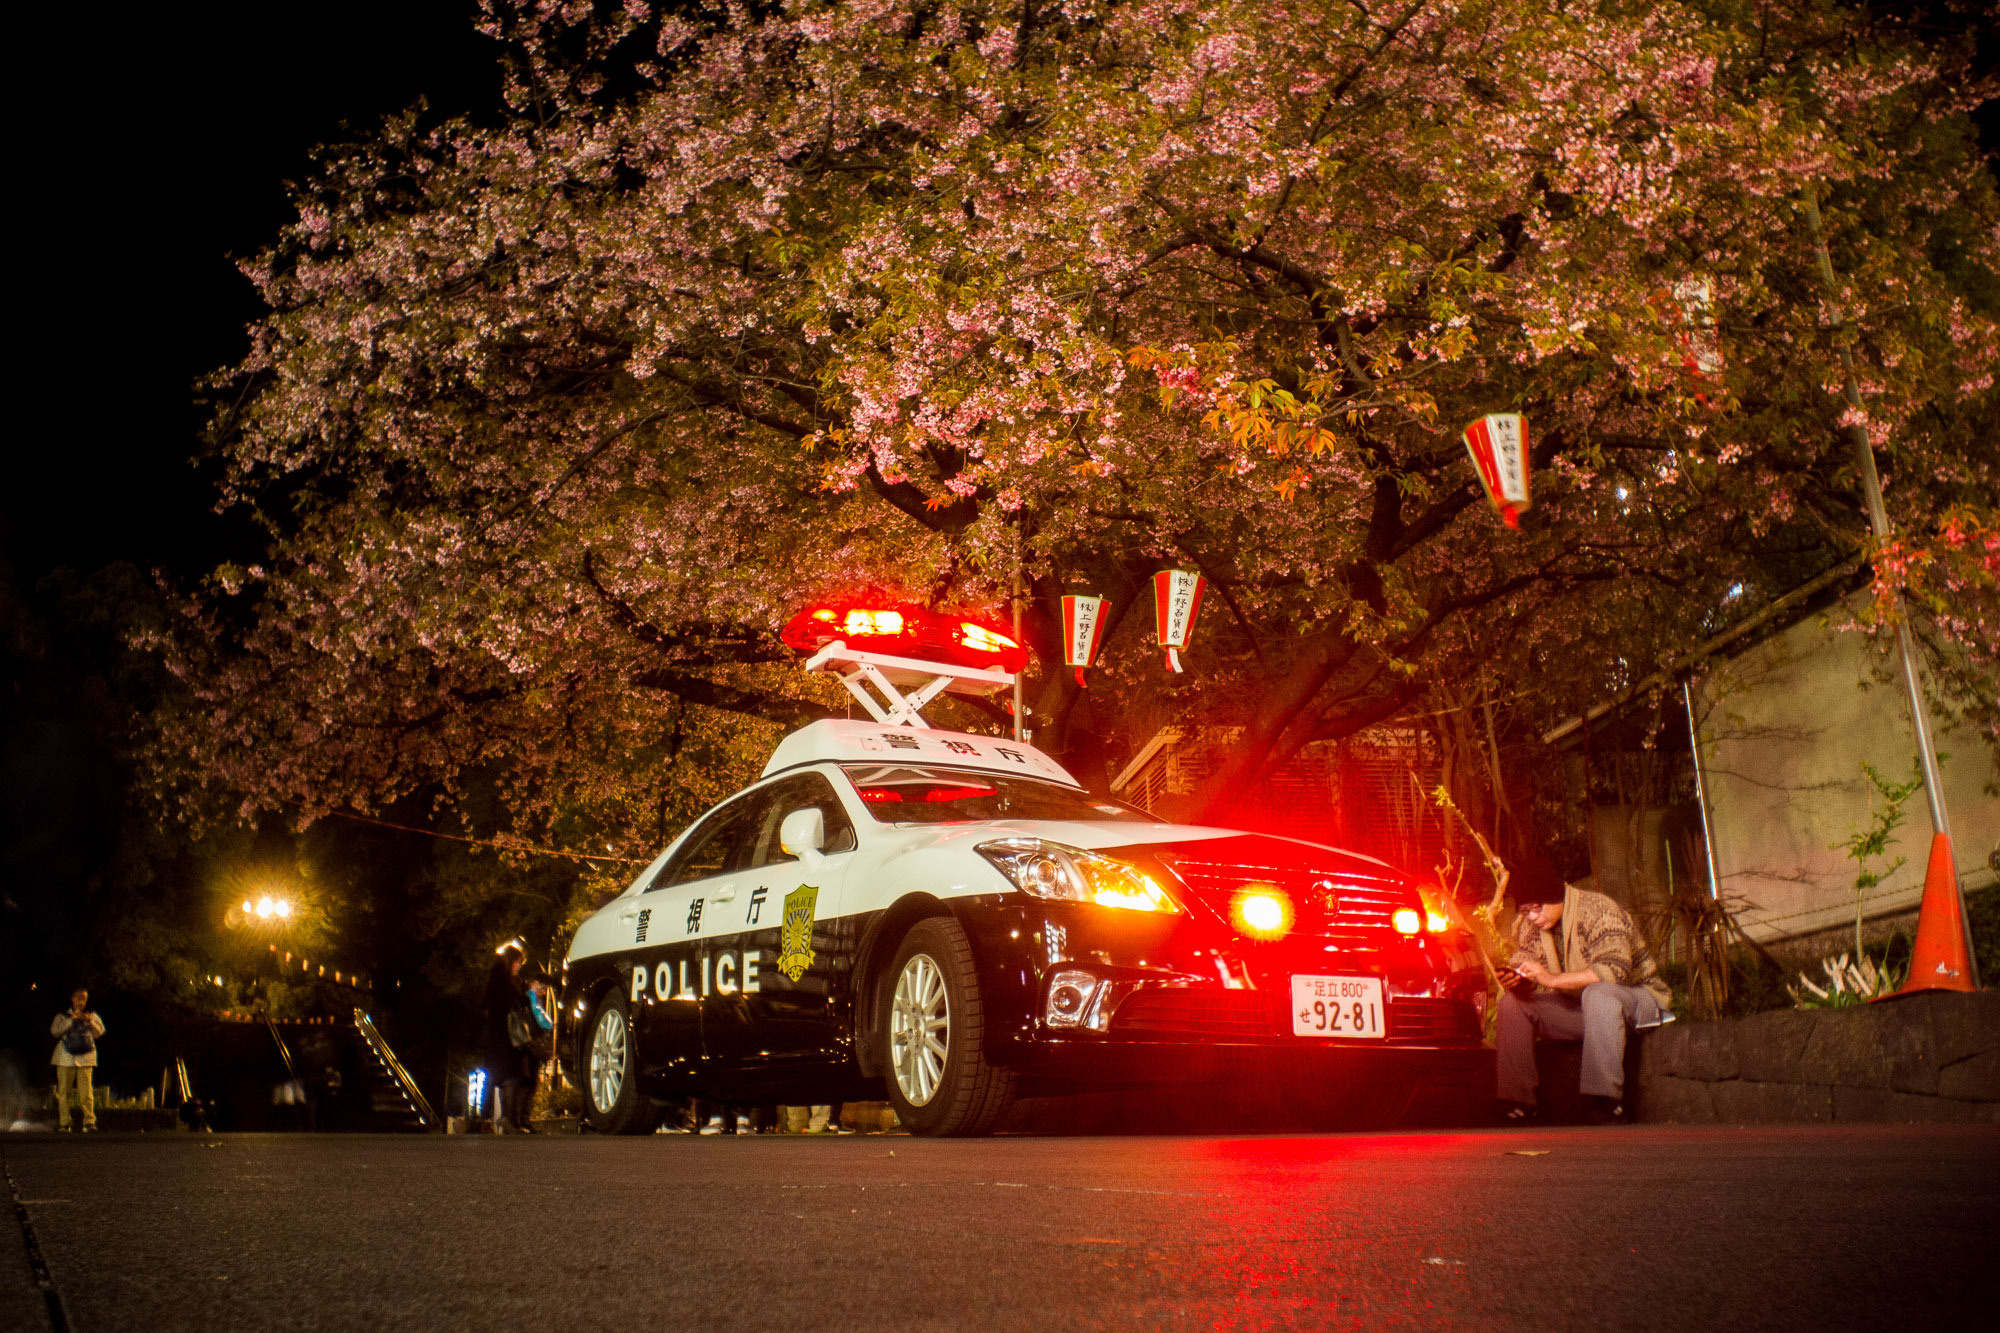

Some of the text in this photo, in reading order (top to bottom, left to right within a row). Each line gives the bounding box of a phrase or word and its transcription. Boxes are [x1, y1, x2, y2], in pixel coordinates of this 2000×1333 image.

[880, 733, 1026, 764] 警視庁
[635, 885, 769, 944] 警視庁
[785, 895, 815, 913] POLICE
[630, 950, 761, 1001] POLICE
[1314, 981, 1363, 998] 足立 800
[1299, 1000, 1377, 1033] せ 92-81
